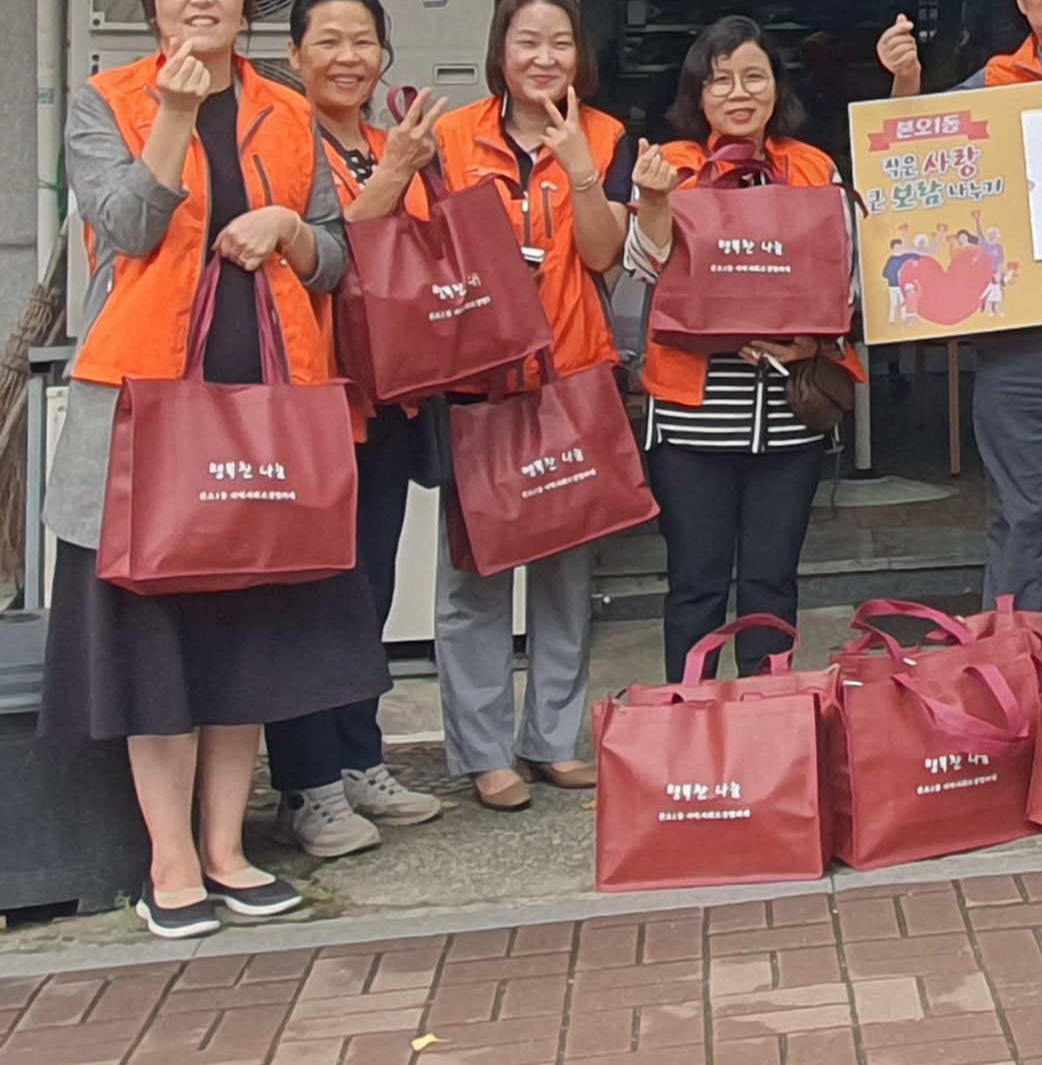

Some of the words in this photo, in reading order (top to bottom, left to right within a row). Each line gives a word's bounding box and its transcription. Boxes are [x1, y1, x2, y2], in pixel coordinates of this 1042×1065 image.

[895, 114, 961, 140] 본오1동
[923, 144, 980, 178] 사랑
[892, 178, 943, 209] 보람
[948, 178, 1003, 200] 나누기
